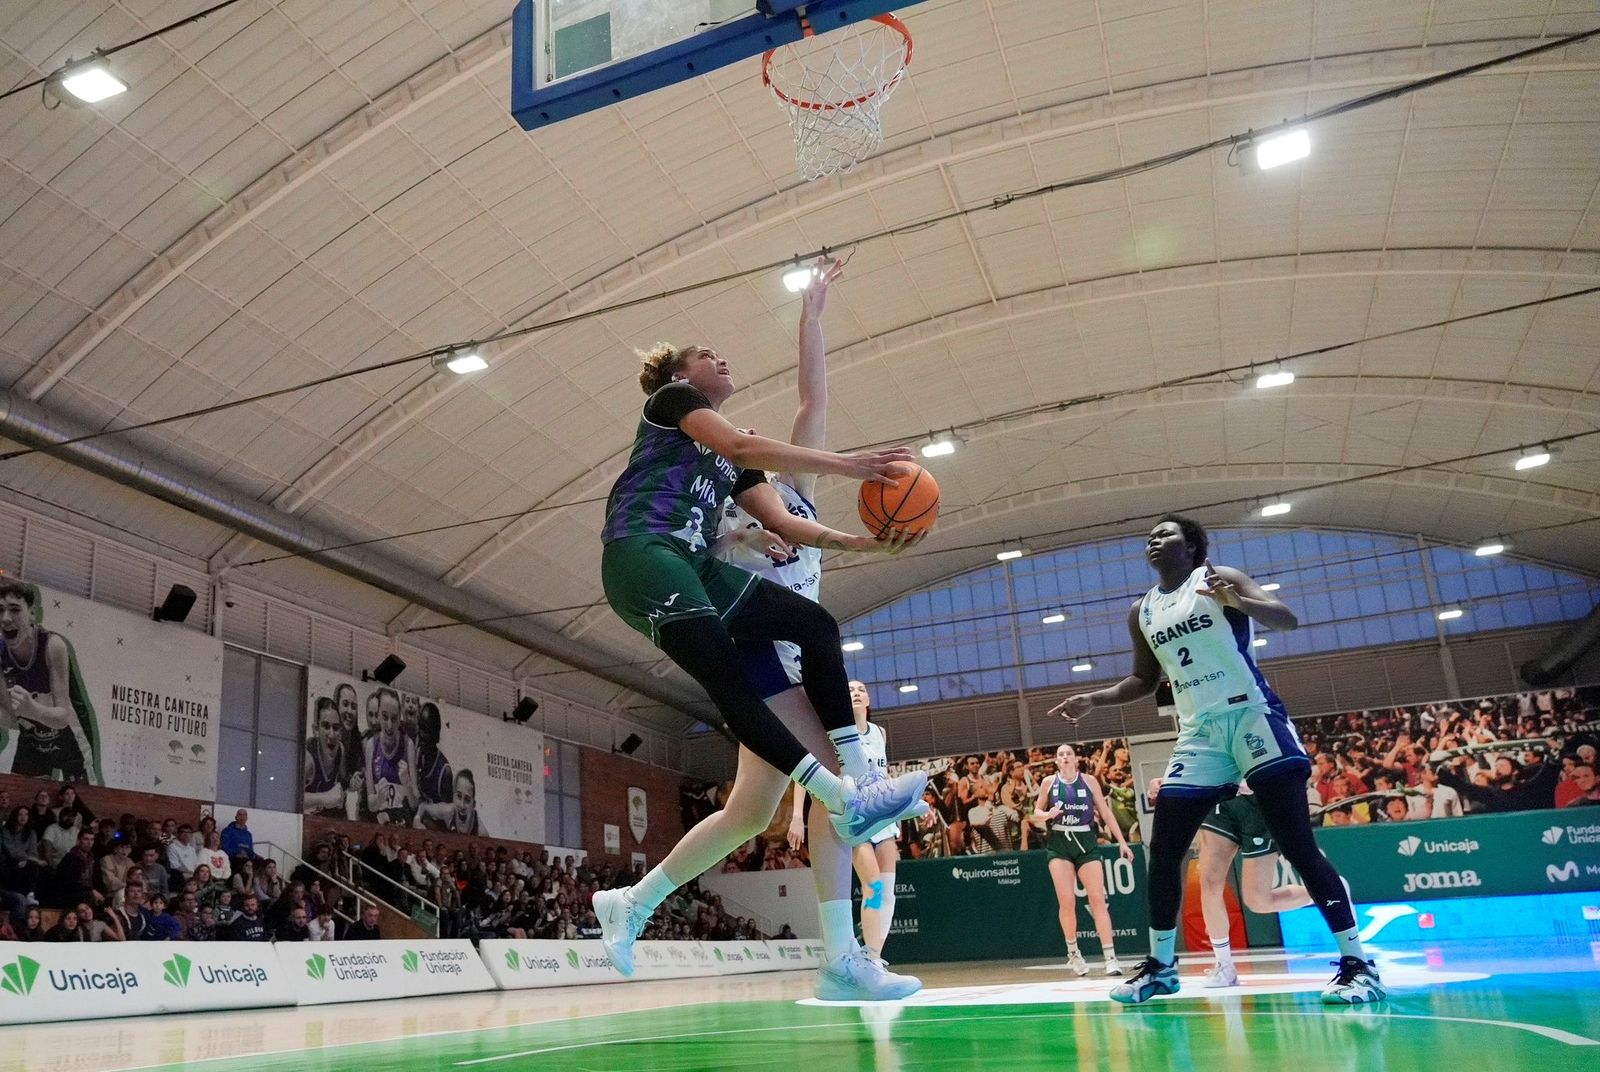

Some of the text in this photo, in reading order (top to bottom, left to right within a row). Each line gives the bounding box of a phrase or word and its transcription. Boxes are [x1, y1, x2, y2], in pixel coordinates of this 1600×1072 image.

[1177, 647, 1193, 667] 2
[111, 683, 209, 720] NUESTRA CANTERA
[111, 703, 207, 738] NUESTRO FUTURO
[1167, 762, 1185, 778] 2
[1064, 803, 1089, 811] Unicaja
[1424, 838, 1480, 854] Unicaja
[328, 951, 388, 967] Fundación
[419, 949, 469, 963] Fundación
[522, 955, 561, 973] Unicaja
[198, 963, 268, 987] Unicaja
[333, 965, 379, 982] Unicaja
[425, 962, 463, 976] Unicaja
[49, 967, 138, 994] Unicaja
